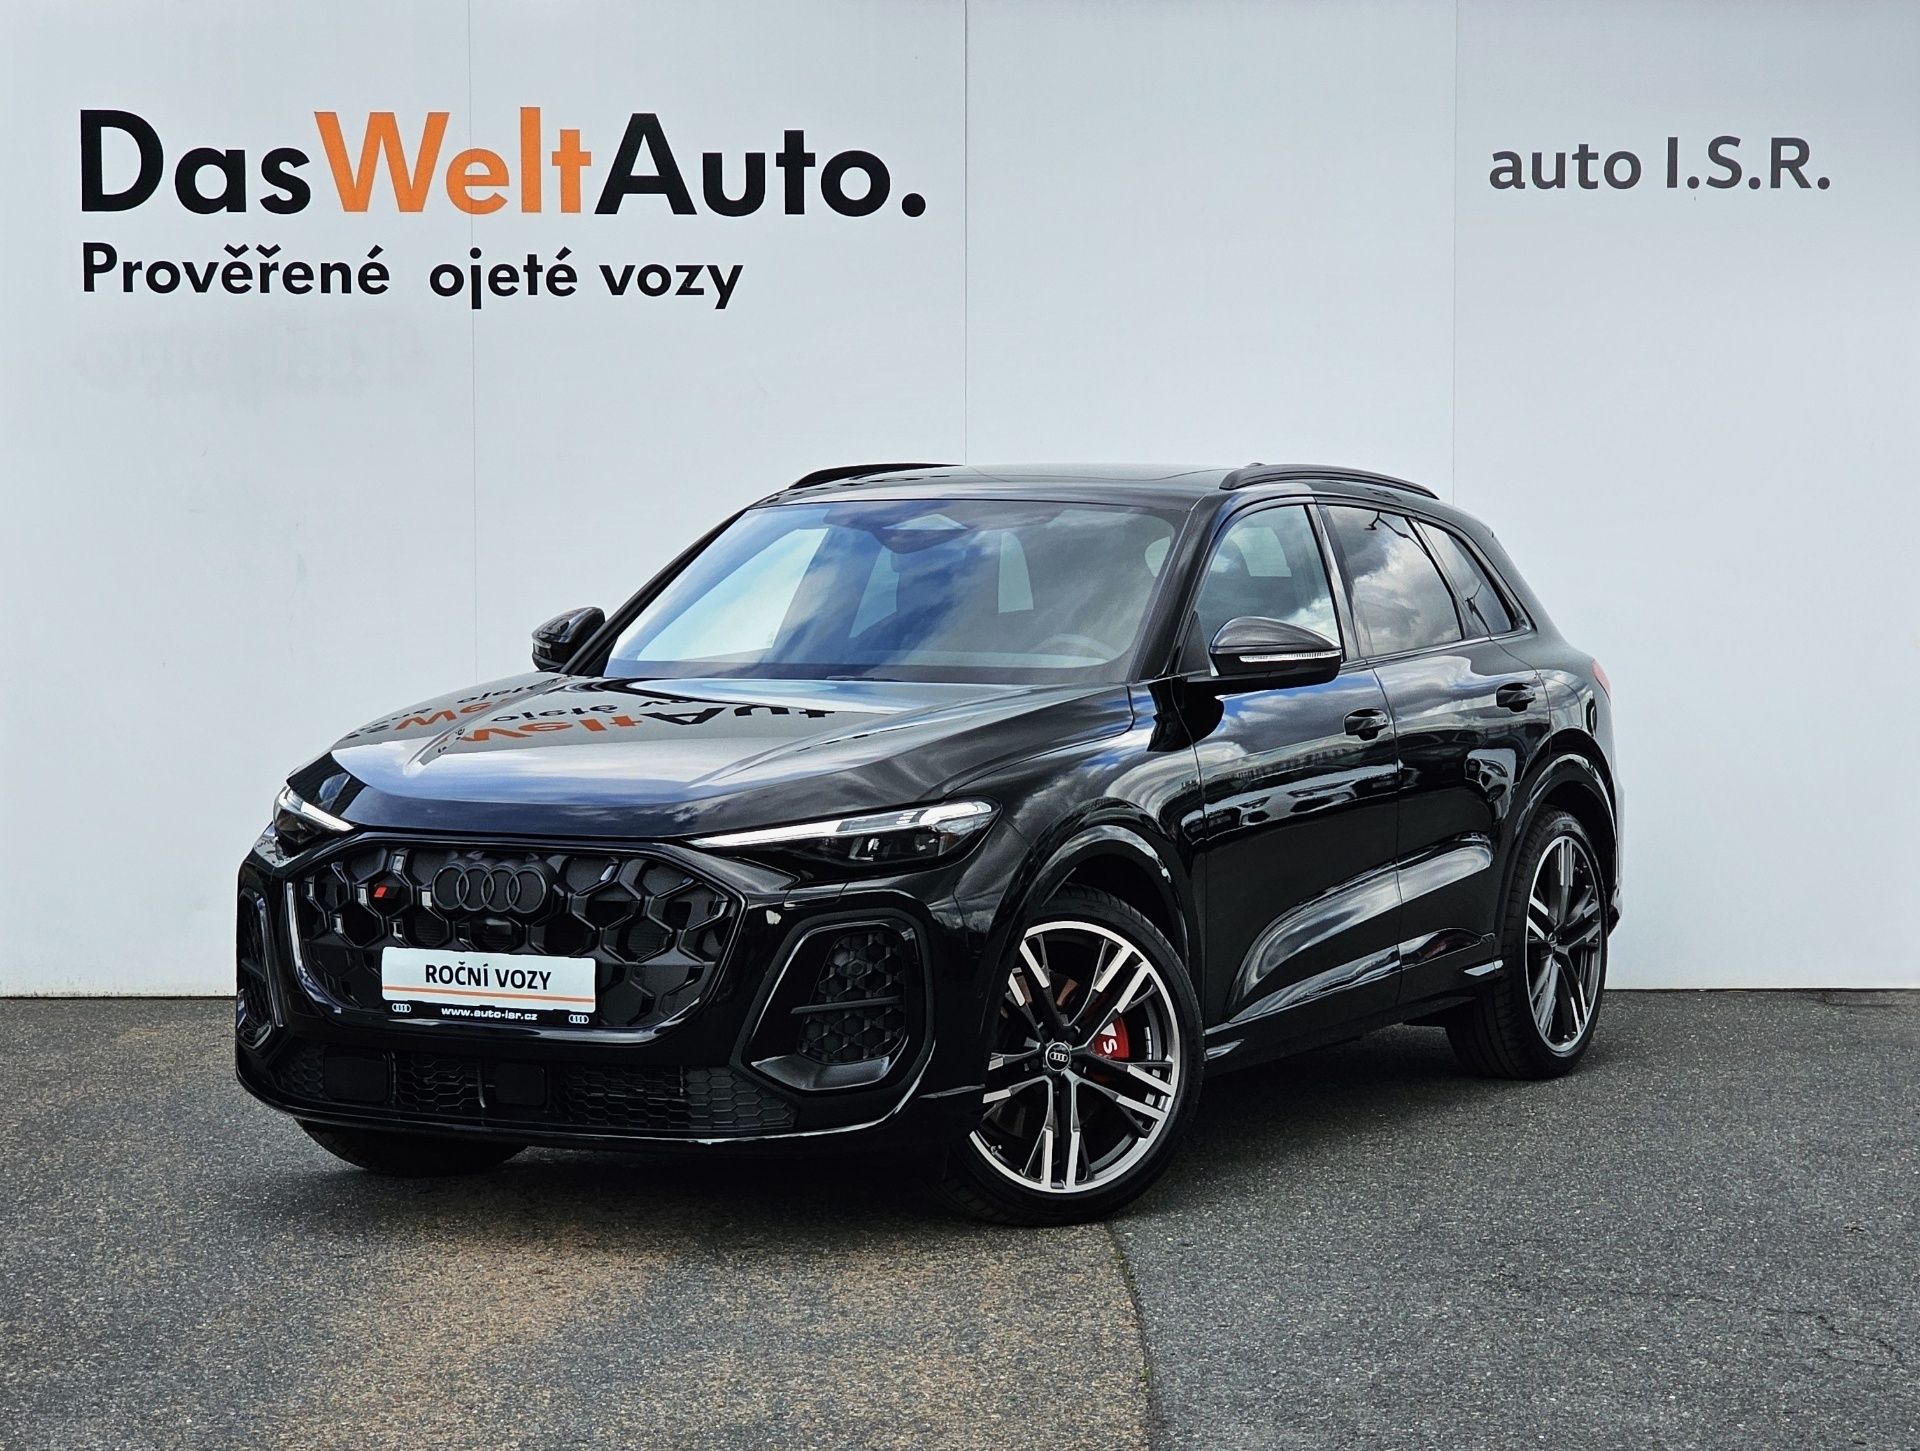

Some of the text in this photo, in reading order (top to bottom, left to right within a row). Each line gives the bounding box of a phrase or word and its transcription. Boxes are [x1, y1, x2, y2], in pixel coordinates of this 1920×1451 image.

[80, 106, 927, 218] DasWeltAuto.
[1489, 135, 1831, 190] auto I.S.R.
[82, 241, 744, 310] Prověřené ojeté vozy
[425, 961, 552, 991] ROČNÍ VOZY
